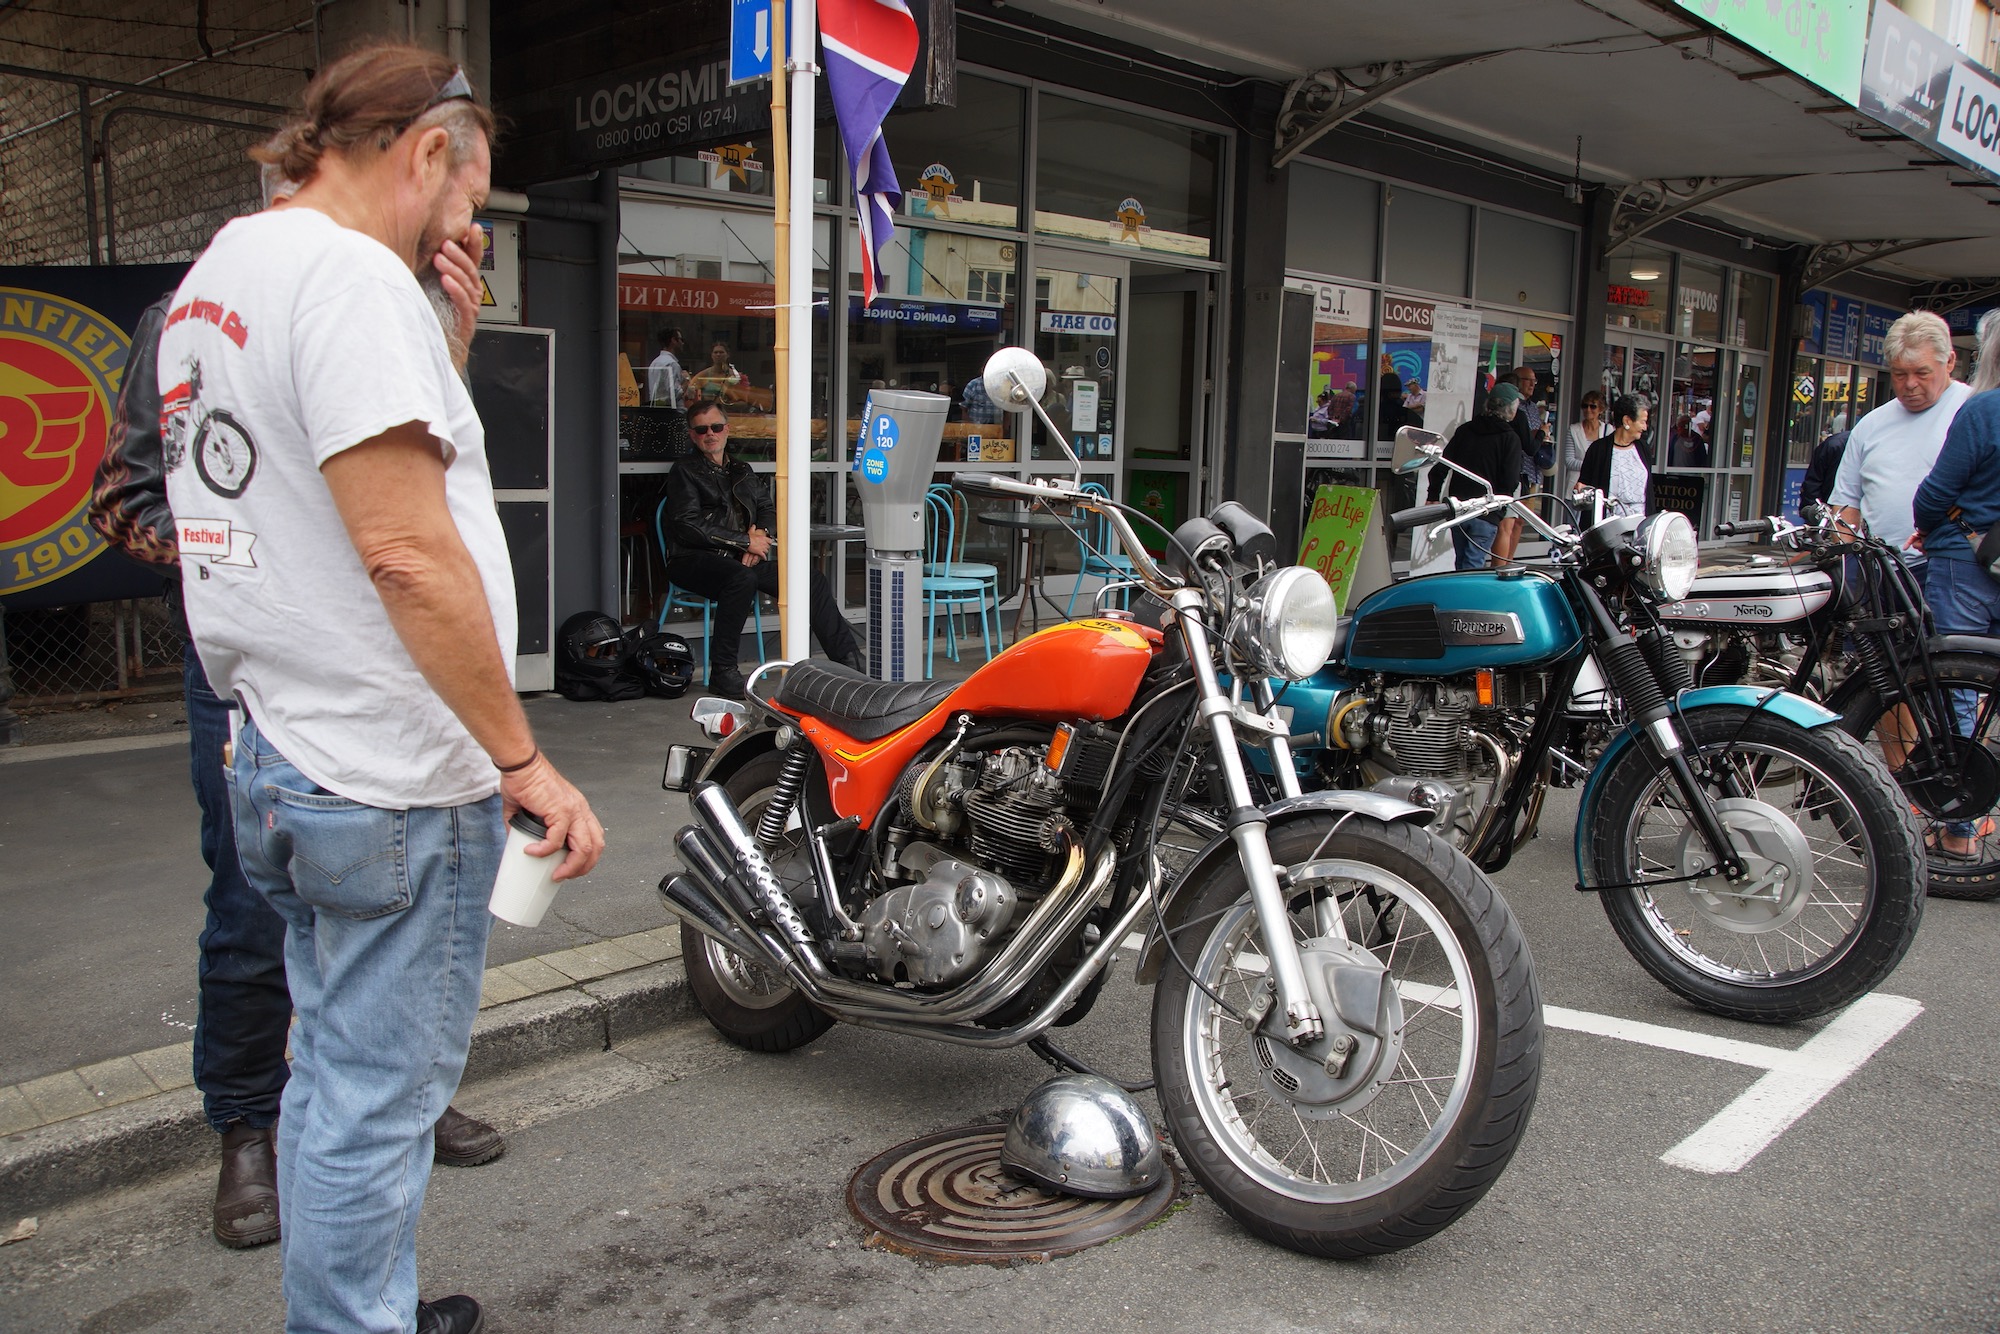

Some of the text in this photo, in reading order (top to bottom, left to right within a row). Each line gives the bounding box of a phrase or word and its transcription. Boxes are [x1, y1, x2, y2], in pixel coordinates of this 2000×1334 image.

[1880, 24, 1936, 111] C.S.I.
[575, 60, 765, 132] LOCKSMIT
[596, 104, 738, 149] 0800 000 CSI (274)
[699, 152, 720, 163] COFFEE
[1002, 247, 1013, 259] 85
[1680, 286, 1718, 313] TATTOOS
[1865, 314, 1880, 329] THE
[860, 401, 873, 440] PAY HERE
[880, 417, 890, 436] P
[876, 436, 894, 448] 120
[1323, 443, 1336, 453] 000
[1337, 444, 1350, 453] 274
[866, 458, 885, 469] ZONE
[867, 466, 883, 476] TWO
[1655, 485, 1698, 497] ATTOO
[1655, 497, 1695, 510] TUDIO
[1311, 495, 1365, 529] Red Eye
[183, 528, 225, 545] Festival
[1733, 604, 1773, 618] Norton
[1451, 618, 1507, 637] TRIUMPH
[1182, 1116, 1257, 1194] AVON
